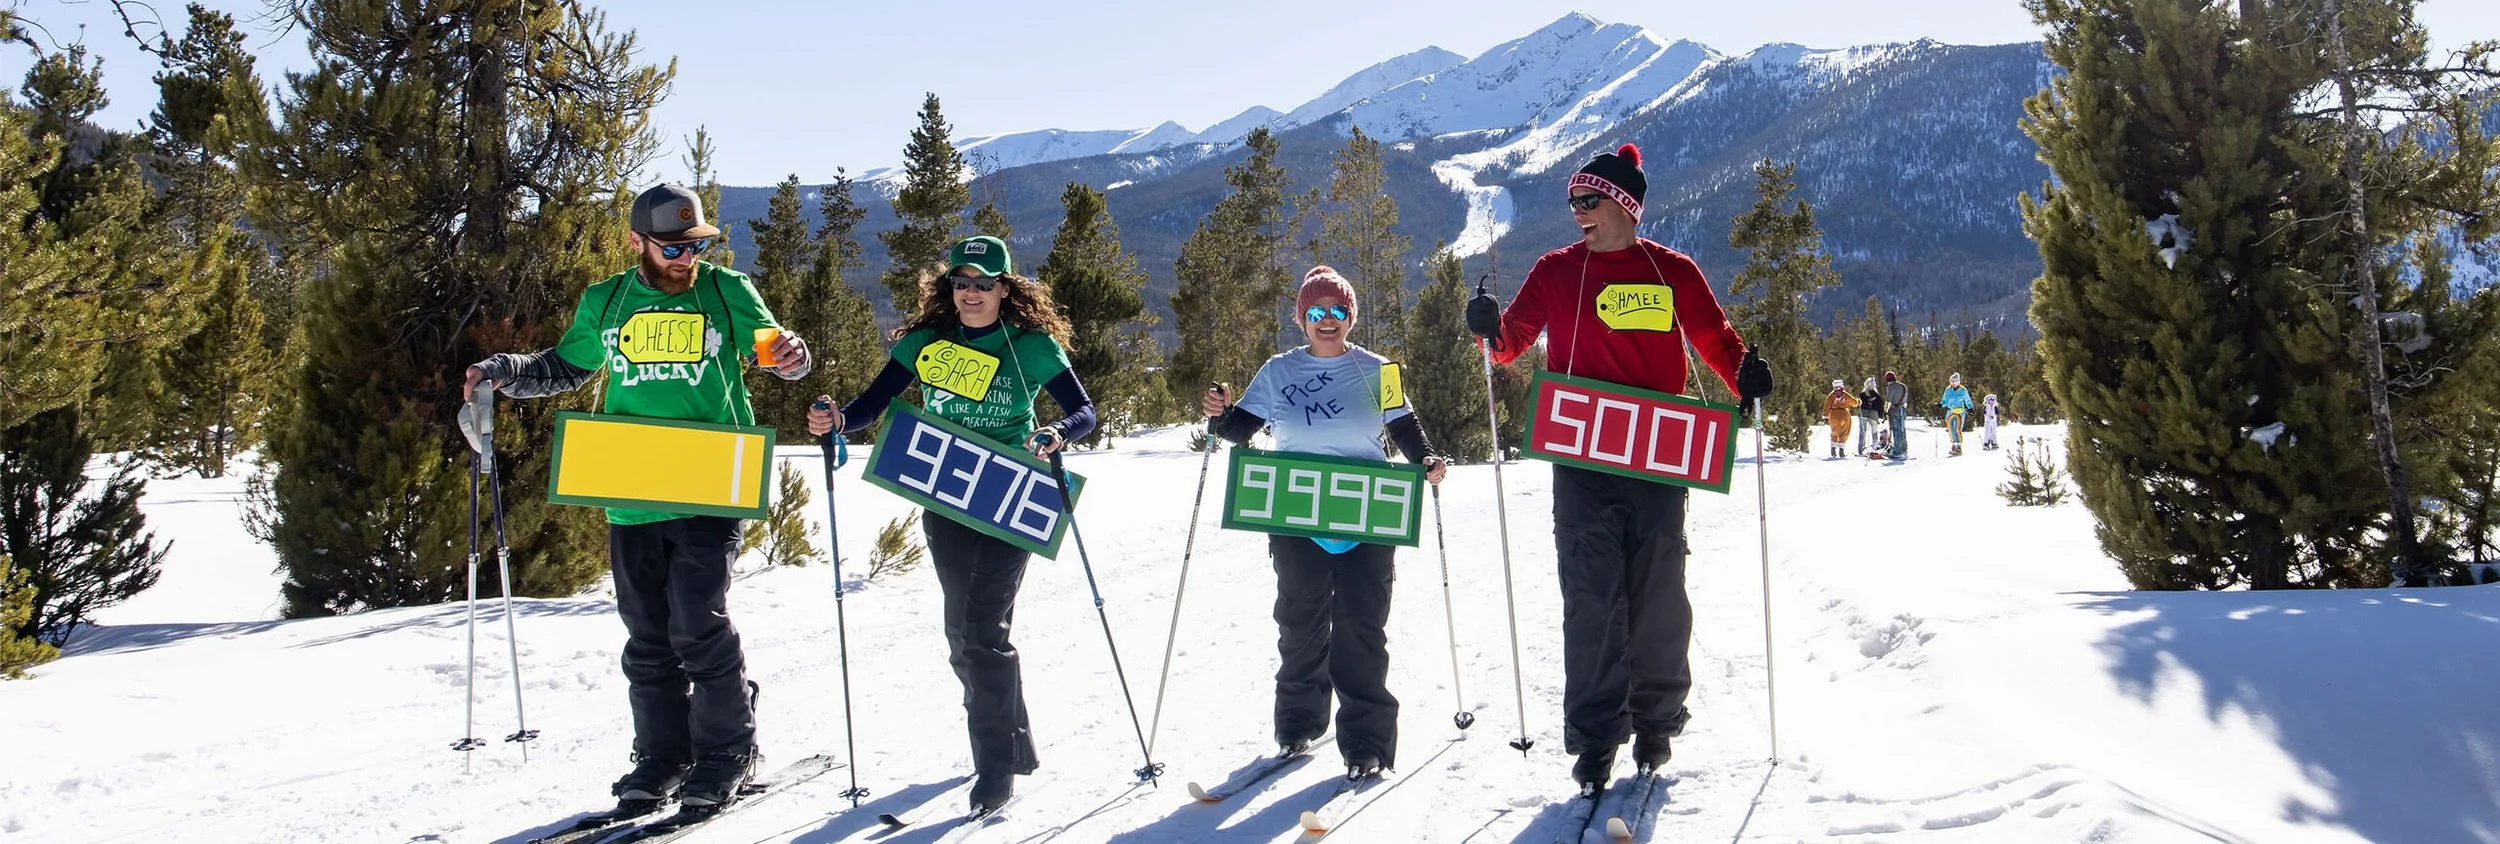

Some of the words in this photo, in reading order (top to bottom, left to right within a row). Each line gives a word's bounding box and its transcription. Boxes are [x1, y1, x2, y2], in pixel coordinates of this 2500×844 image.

[1576, 174, 1638, 214] BURTON
[1607, 288, 1661, 316] SHMEE
[633, 318, 699, 354] CHEESE
[927, 343, 990, 397] SARA
[1281, 371, 1333, 407] PICK
[950, 403, 970, 414] LIKE
[976, 404, 983, 414] A
[988, 405, 1011, 417] FISH
[1305, 398, 1344, 426] ME
[1545, 390, 1717, 480] 5001
[731, 435, 744, 504] 1
[899, 421, 1058, 541] 9376
[1239, 464, 1413, 536] 9999
